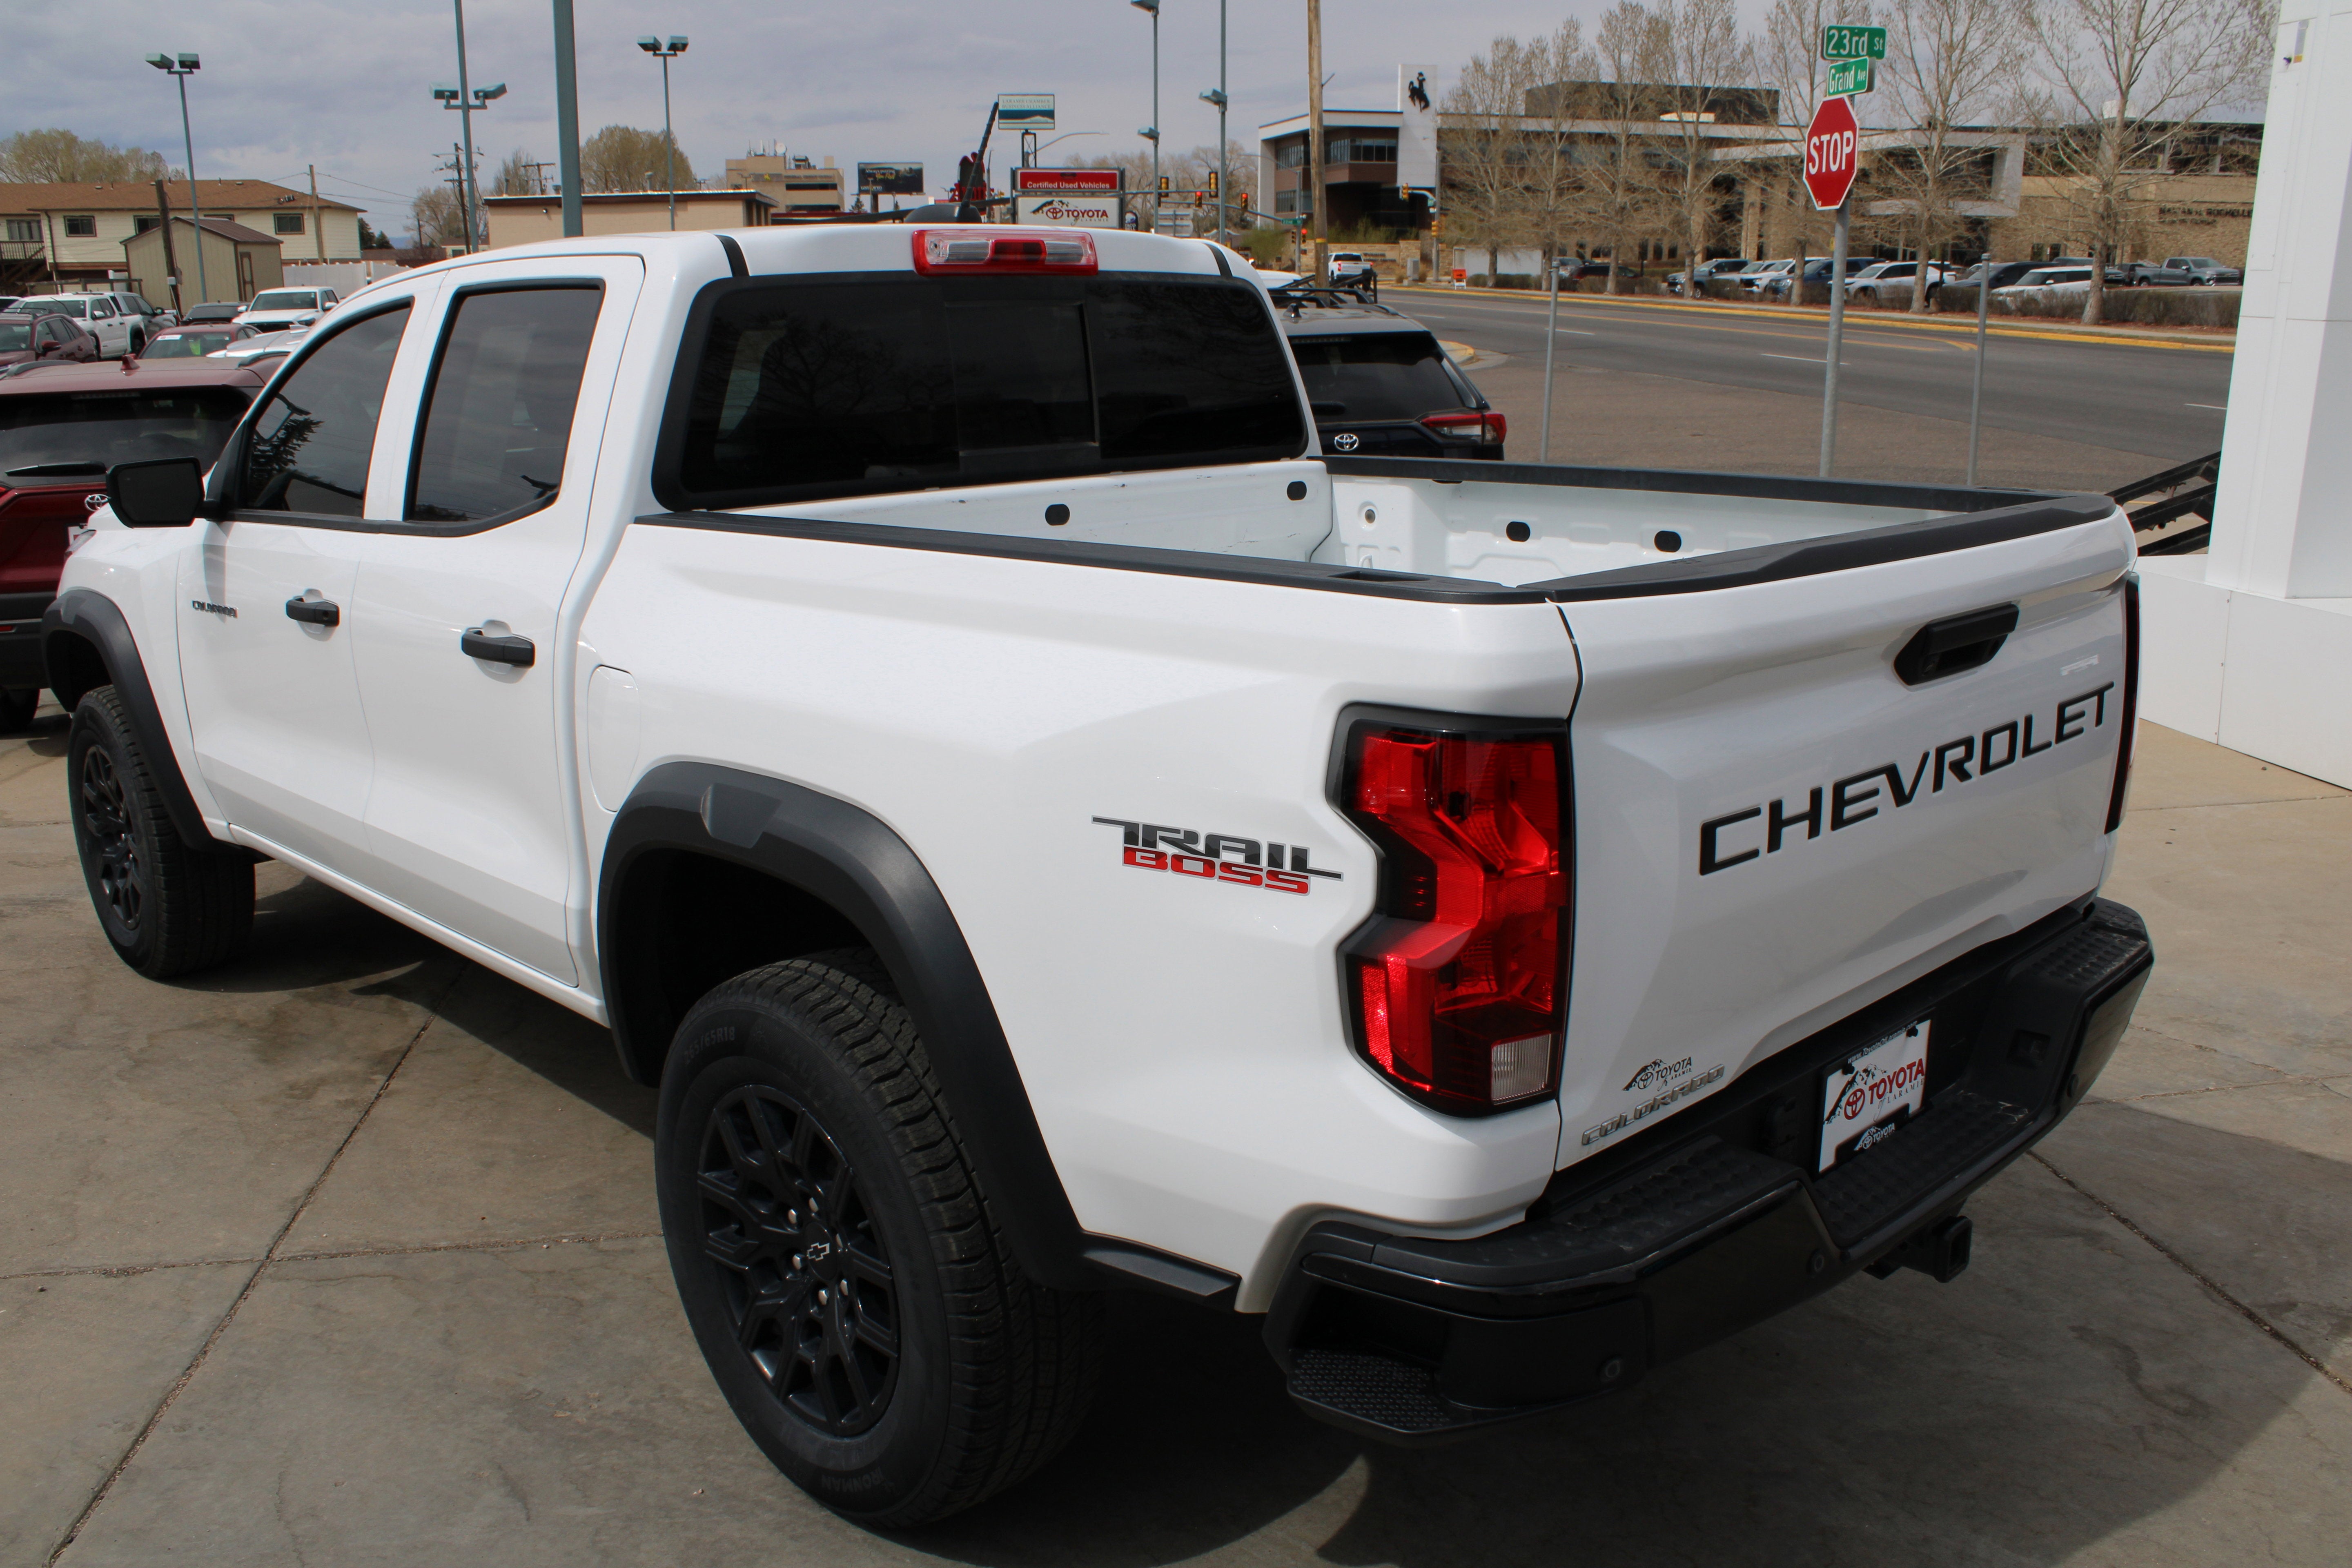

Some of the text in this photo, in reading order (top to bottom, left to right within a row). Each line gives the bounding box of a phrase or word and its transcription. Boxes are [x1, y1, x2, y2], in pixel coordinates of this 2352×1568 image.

[1827, 29, 1884, 56] 23rd St
[1829, 65, 1866, 93] Grand Ave
[1809, 130, 1854, 175] STOP
[1065, 209, 1109, 218] TOYOTA
[1699, 681, 2114, 875] CHEVROLET
[1091, 815, 1343, 882] TRAIL
[1123, 845, 1311, 896] BOSS
[1655, 1056, 1692, 1081] TOYOTA
[1868, 1058, 1925, 1105] TOYOTA
[1581, 1063, 1724, 1146] COLORADO
[1887, 1078, 1924, 1103] LARAMIE
[1873, 1123, 1895, 1143] TOYOTA
